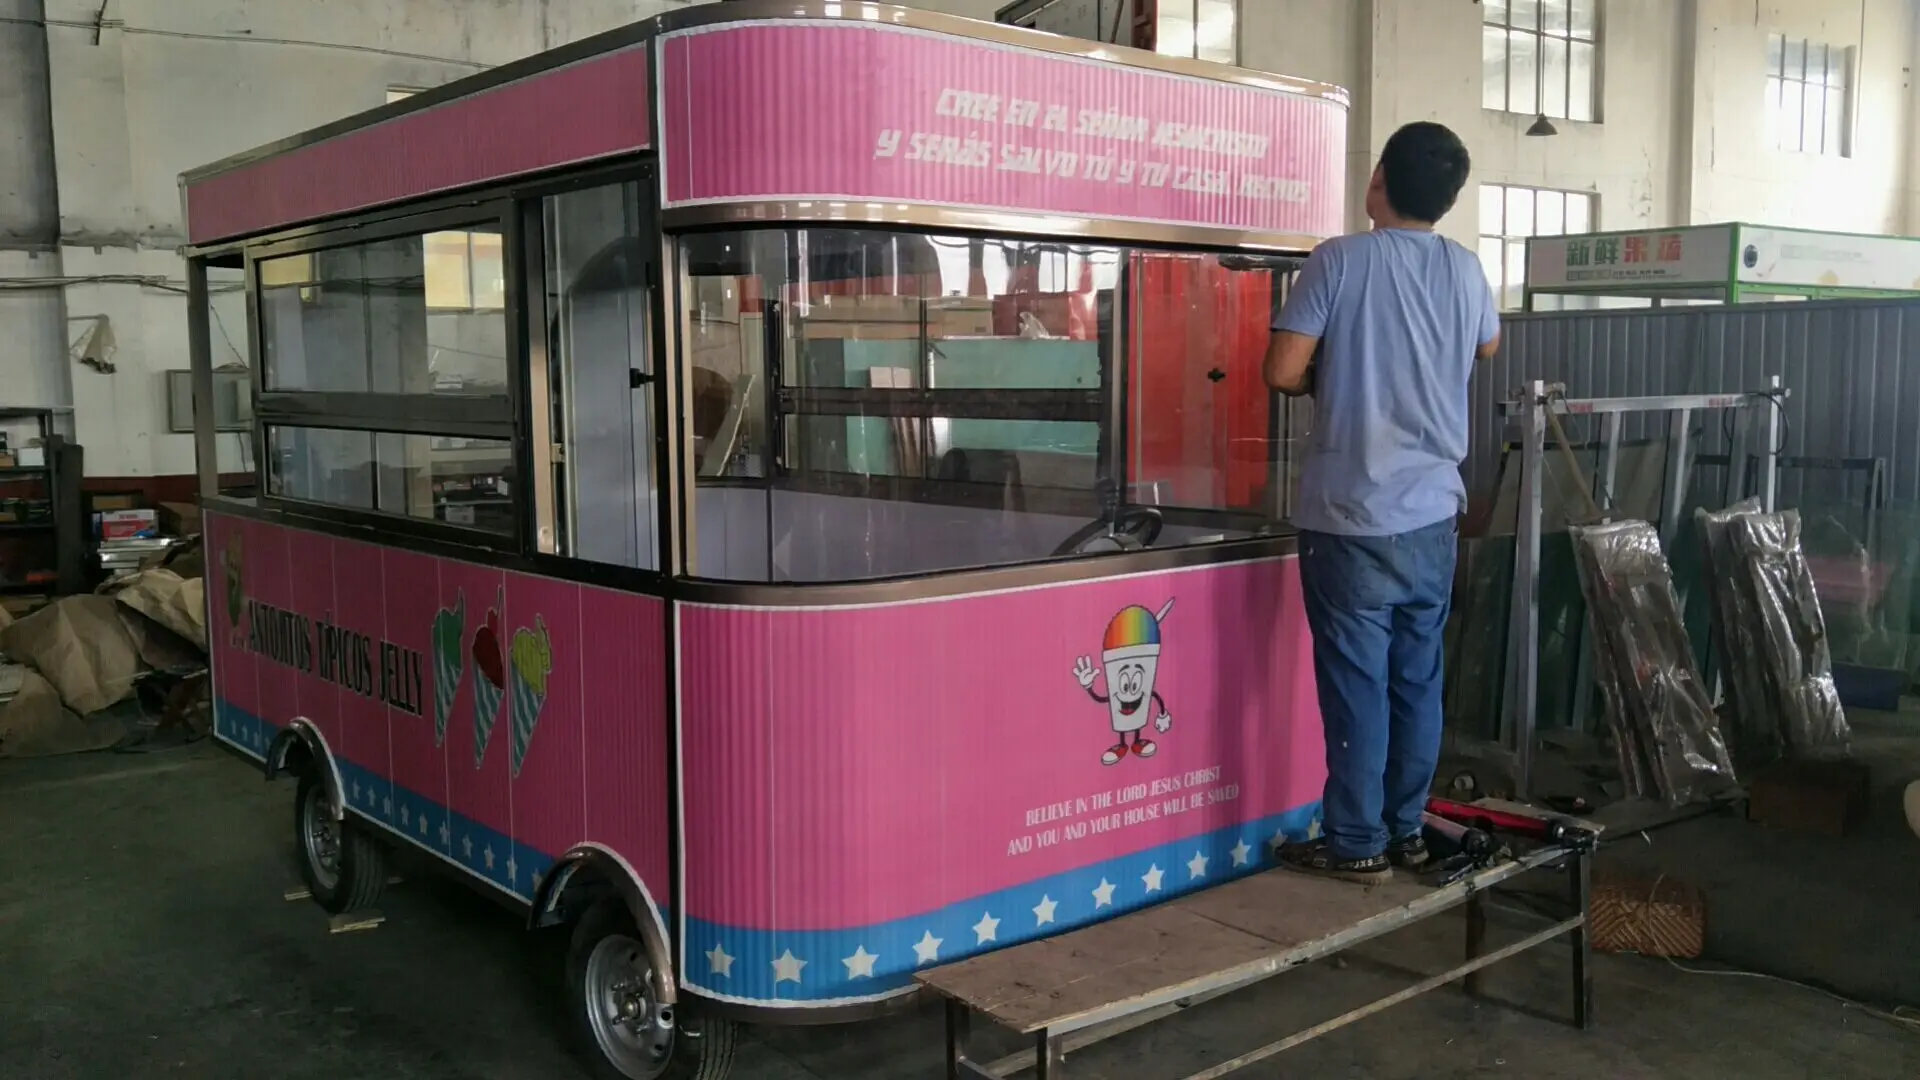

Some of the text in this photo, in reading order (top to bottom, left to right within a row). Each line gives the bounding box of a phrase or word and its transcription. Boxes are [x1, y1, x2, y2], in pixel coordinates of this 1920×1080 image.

[380, 640, 423, 716] JELLY
[1007, 782, 1239, 856] AND YOU AND YOUR HOUSE WILL BE SAVED
[1026, 766, 1221, 826] BELIEVE IN THE LORD JESUS CHRIST
